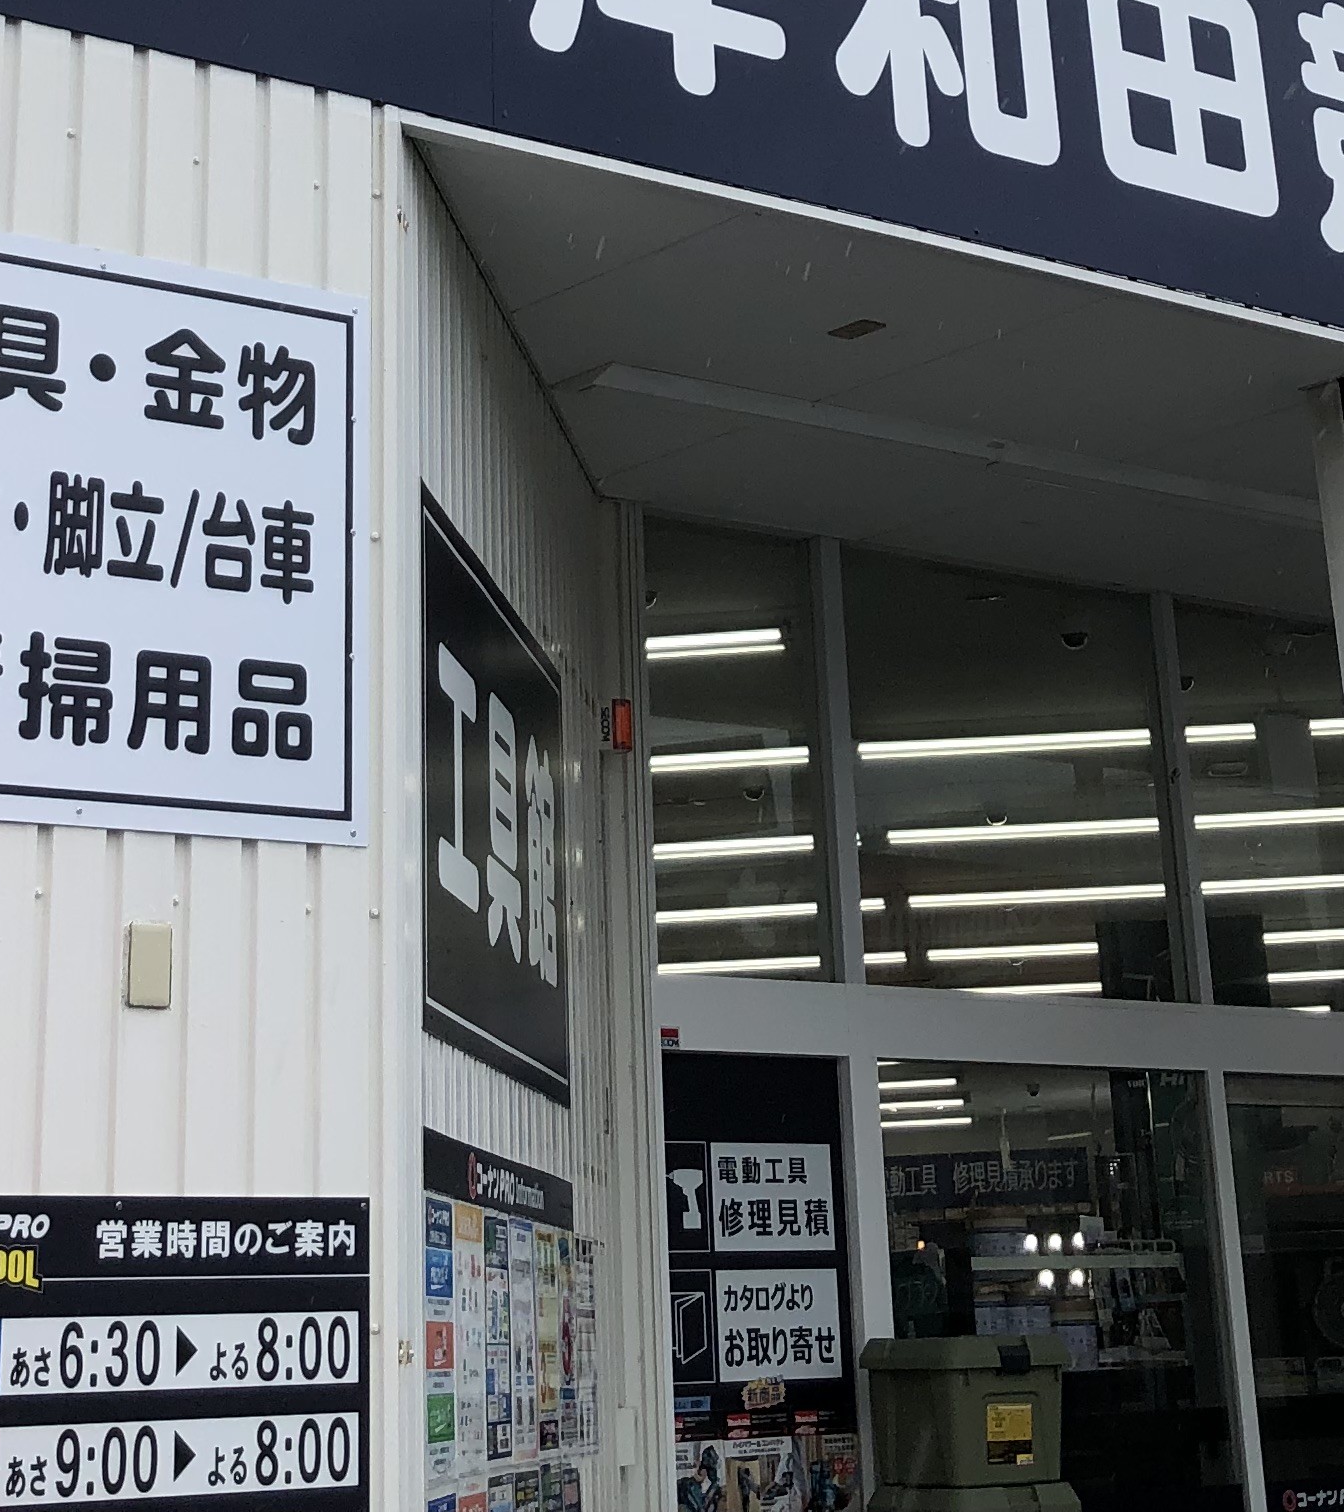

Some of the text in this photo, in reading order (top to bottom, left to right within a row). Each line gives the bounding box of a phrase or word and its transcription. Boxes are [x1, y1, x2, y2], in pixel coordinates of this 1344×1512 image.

[717, 1155, 808, 1185] 電動工具
[885, 1159, 1079, 1198] 動工具 修理見積承ります
[718, 1197, 831, 1238] 修理見積
[96, 1219, 357, 1260] 営業時間のご案内
[722, 1283, 814, 1313] カタログより
[723, 1325, 836, 1369] お取り寄せ
